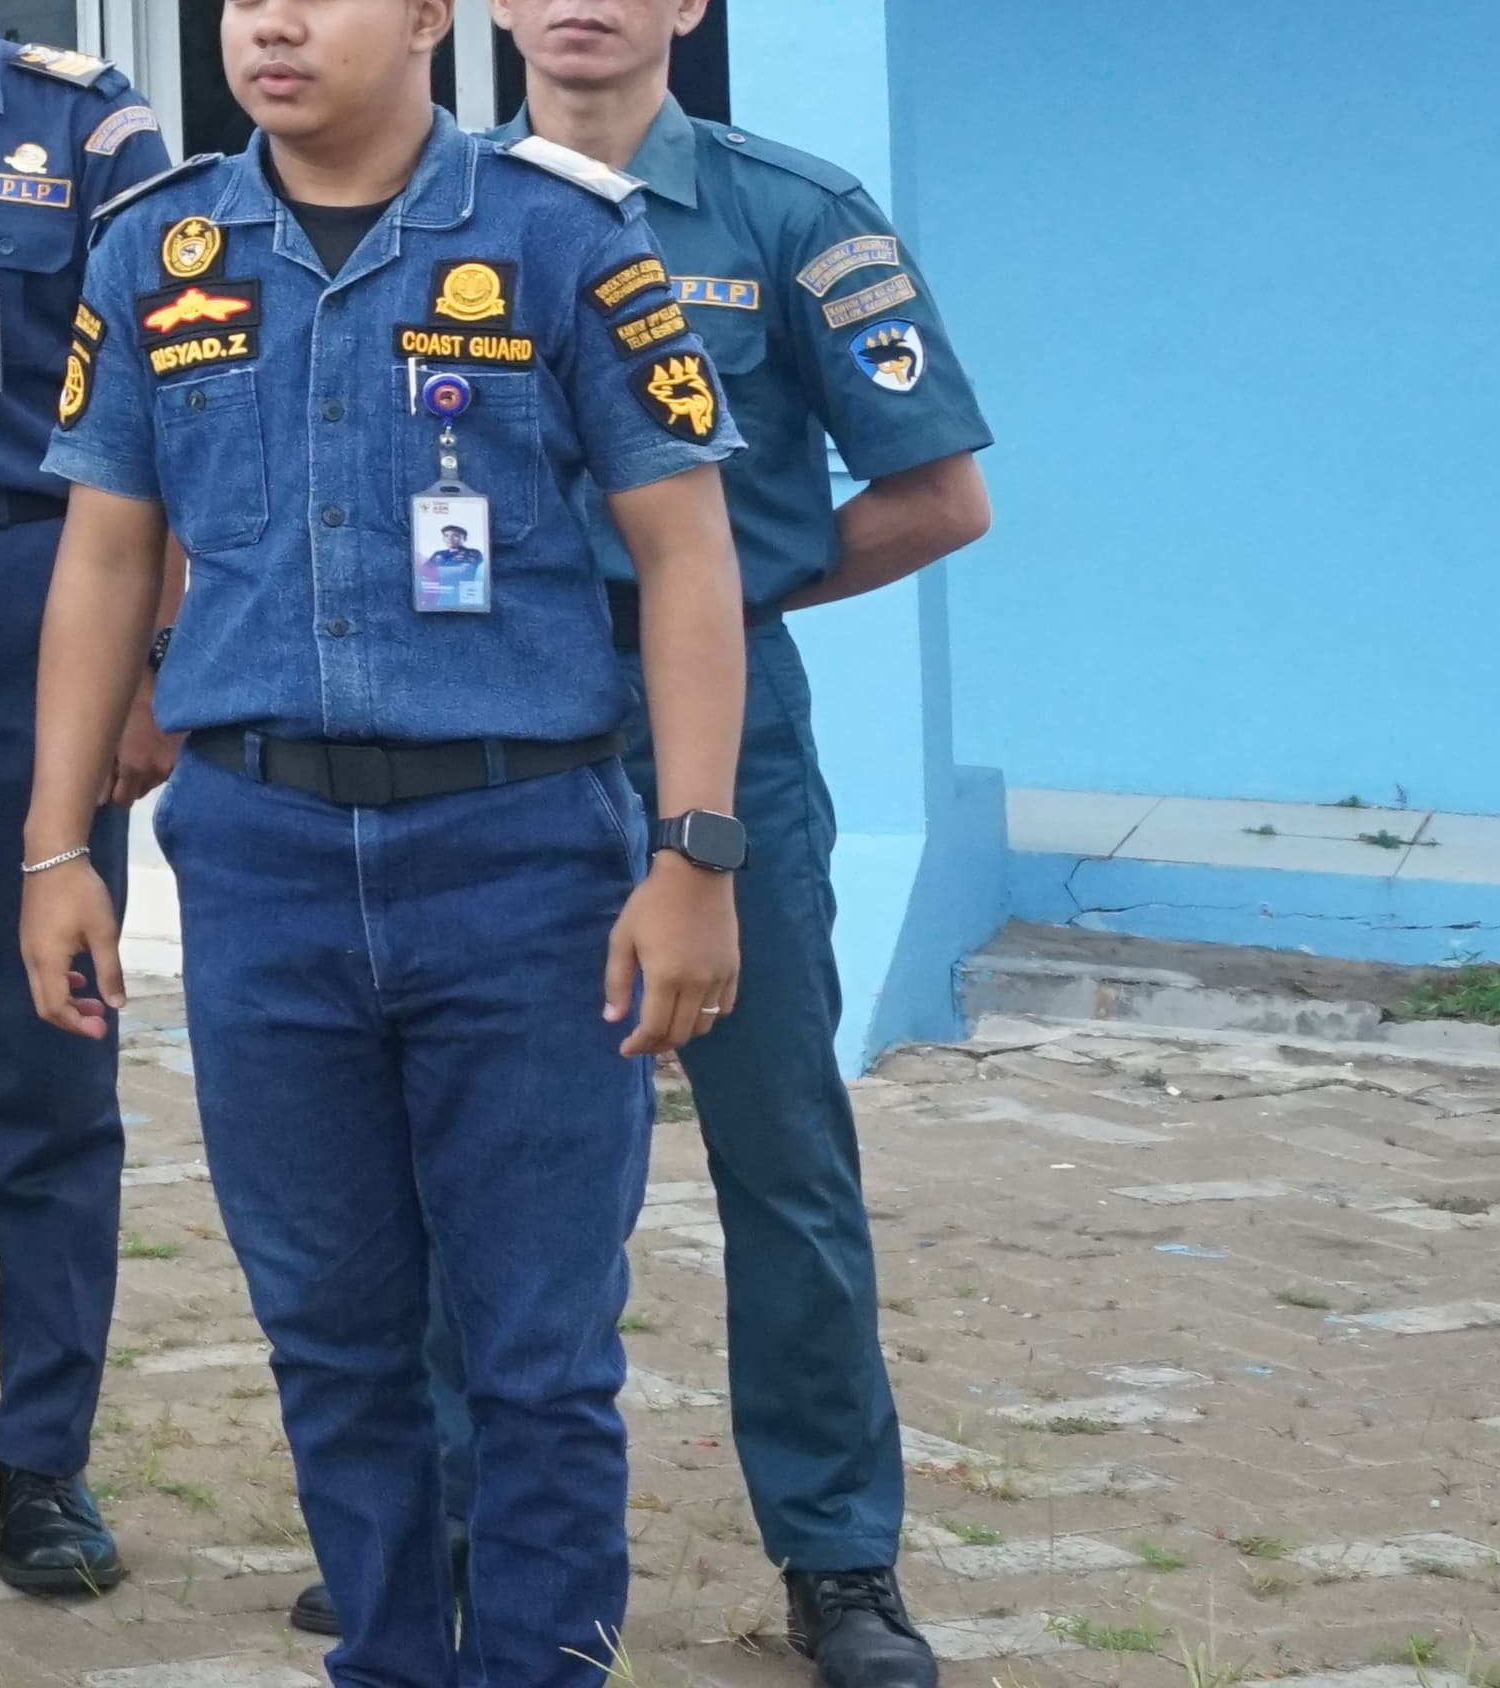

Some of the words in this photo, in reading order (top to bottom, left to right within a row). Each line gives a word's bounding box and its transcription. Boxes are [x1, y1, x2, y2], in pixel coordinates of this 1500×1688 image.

[680, 280, 747, 303] PLP
[149, 332, 248, 377] RISYAD.Z
[401, 330, 464, 358] COAST
[468, 335, 533, 361] GUARD
